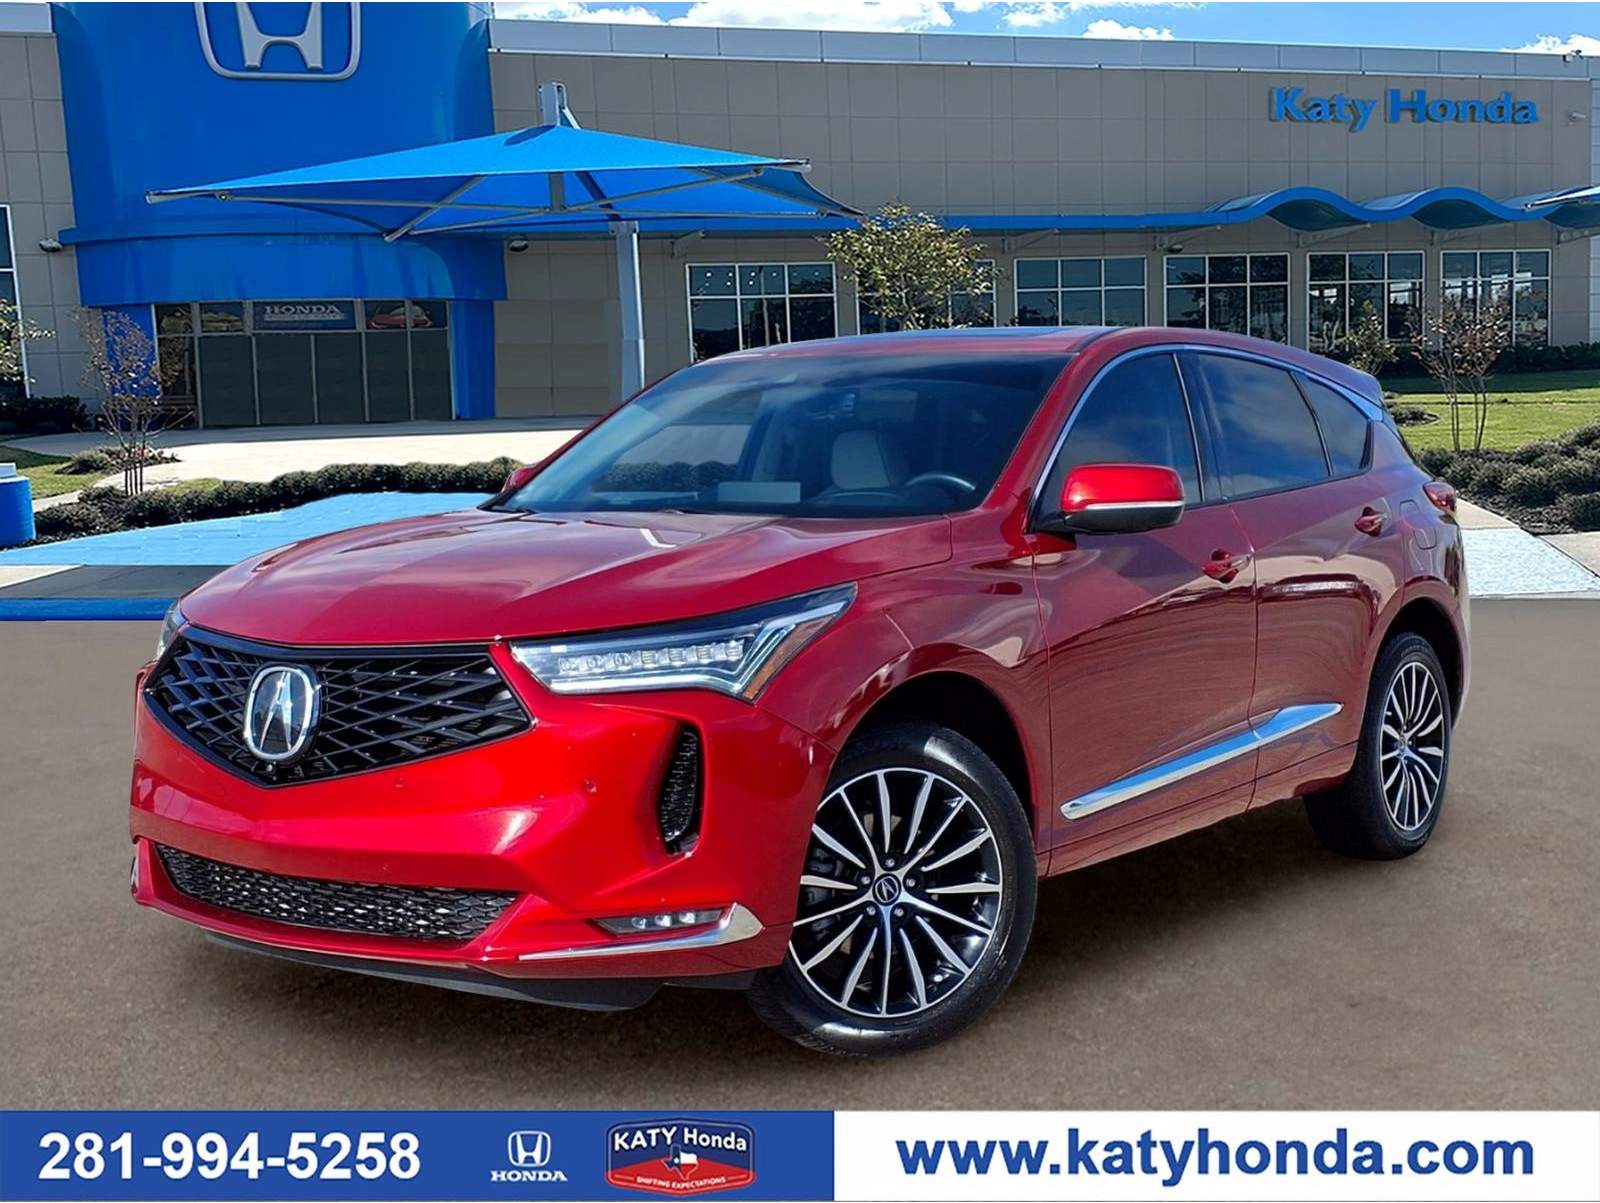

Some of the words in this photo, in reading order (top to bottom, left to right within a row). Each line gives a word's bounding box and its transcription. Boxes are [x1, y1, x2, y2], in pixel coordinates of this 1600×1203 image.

[1270, 87, 1377, 132] Katy
[1386, 88, 1541, 124] Honda
[264, 304, 342, 315] HONDA
